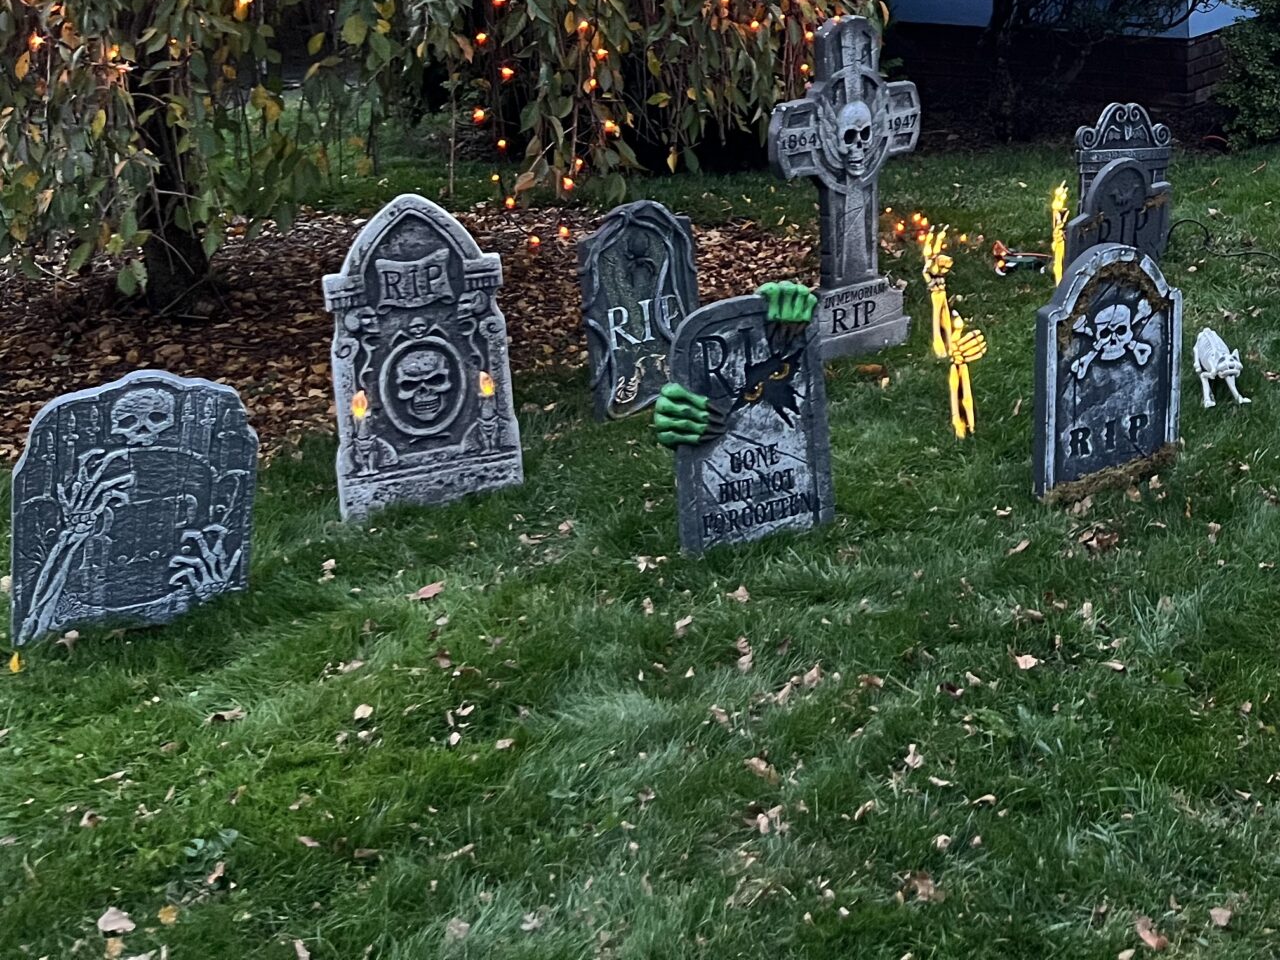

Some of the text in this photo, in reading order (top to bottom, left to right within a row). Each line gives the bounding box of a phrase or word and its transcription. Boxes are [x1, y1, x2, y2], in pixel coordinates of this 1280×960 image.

[887, 113, 918, 132] 1947
[781, 132, 817, 150] 1864
[381, 264, 443, 300] RIP
[608, 294, 679, 351] RIP
[832, 300, 876, 334] RIP
[1068, 413, 1148, 458] RIP
[729, 443, 780, 474] GONE
[719, 468, 795, 505] BUT NOT
[703, 491, 819, 538] FORGOTTEN
